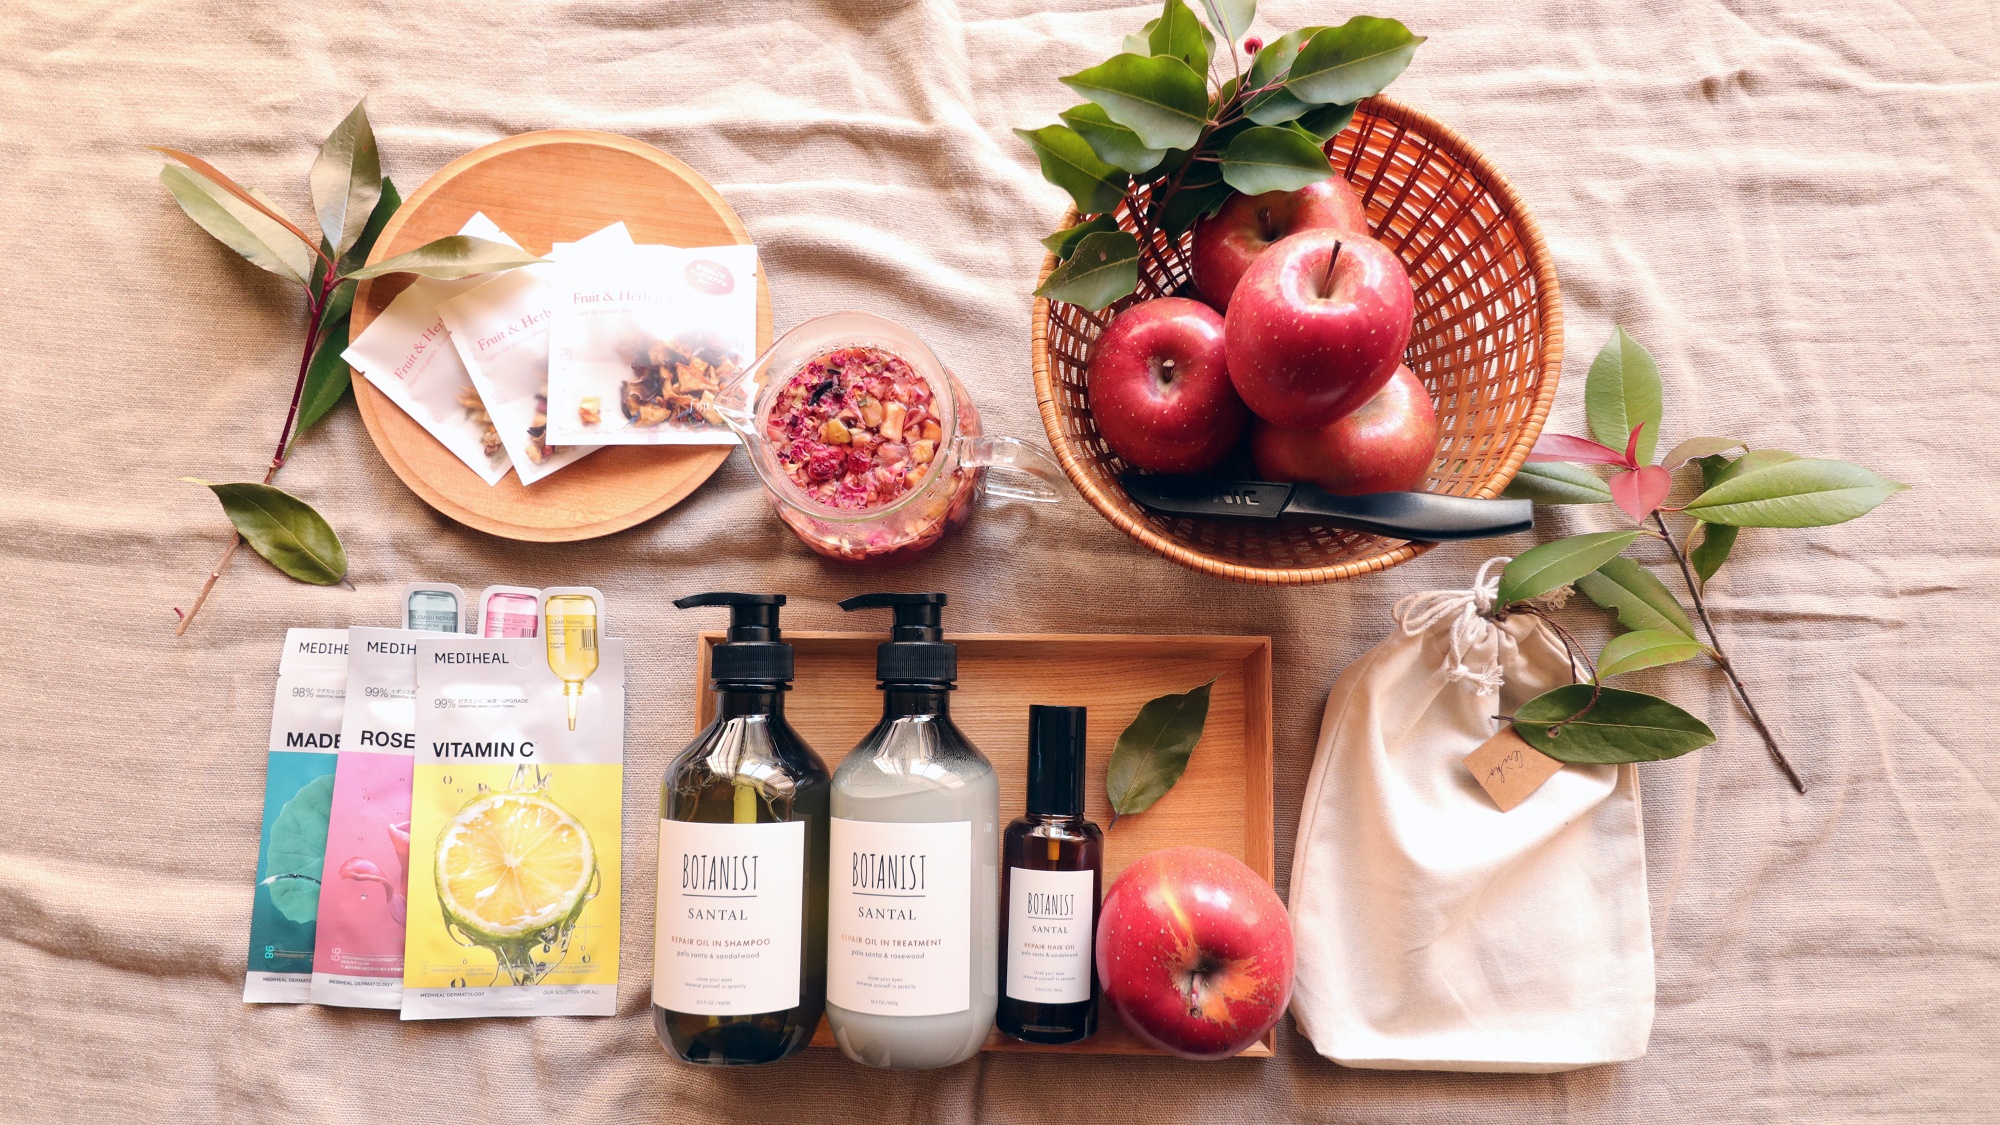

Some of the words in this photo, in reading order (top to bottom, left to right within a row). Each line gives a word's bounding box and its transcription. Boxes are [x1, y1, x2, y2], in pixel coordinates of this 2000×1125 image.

[573, 291, 600, 304] Fruit
[603, 290, 614, 302] &
[619, 290, 651, 302] Herb
[477, 331, 506, 351] Fruit
[508, 324, 521, 335] &
[521, 308, 551, 328] Herb
[394, 353, 418, 380] Fruit
[413, 341, 427, 354] &
[422, 316, 444, 342] Her
[434, 651, 510, 665] MEDIHEAL
[292, 686, 314, 698] 98%
[364, 686, 389, 698] 99%
[434, 698, 456, 709] 99%
[286, 732, 341, 750] MADE
[360, 730, 415, 750] ROSE
[433, 741, 516, 759] VITAMIN
[519, 741, 535, 758] C
[682, 853, 759, 891] BOTANIST
[852, 851, 926, 891] BOTANIST
[1028, 892, 1074, 916] BOTANIST
[687, 907, 748, 921] SANTAL
[858, 906, 917, 921] SANTAL
[1032, 925, 1069, 934] SANTAL
[671, 935, 694, 946] REPAIR
[697, 937, 710, 948] OIL
[712, 937, 723, 948] IN
[724, 936, 771, 948] SHAMPOO
[841, 933, 863, 945] REPAIR
[864, 936, 878, 946] OIL
[880, 938, 890, 947] IN
[892, 938, 943, 947] TREATMENT
[1024, 942, 1046, 950] REPAIR
[264, 944, 275, 960] 98
[330, 947, 342, 962] 99
[690, 951, 708, 960] santo
[716, 951, 760, 960] sandalwood
[890, 952, 925, 960] rosewood
